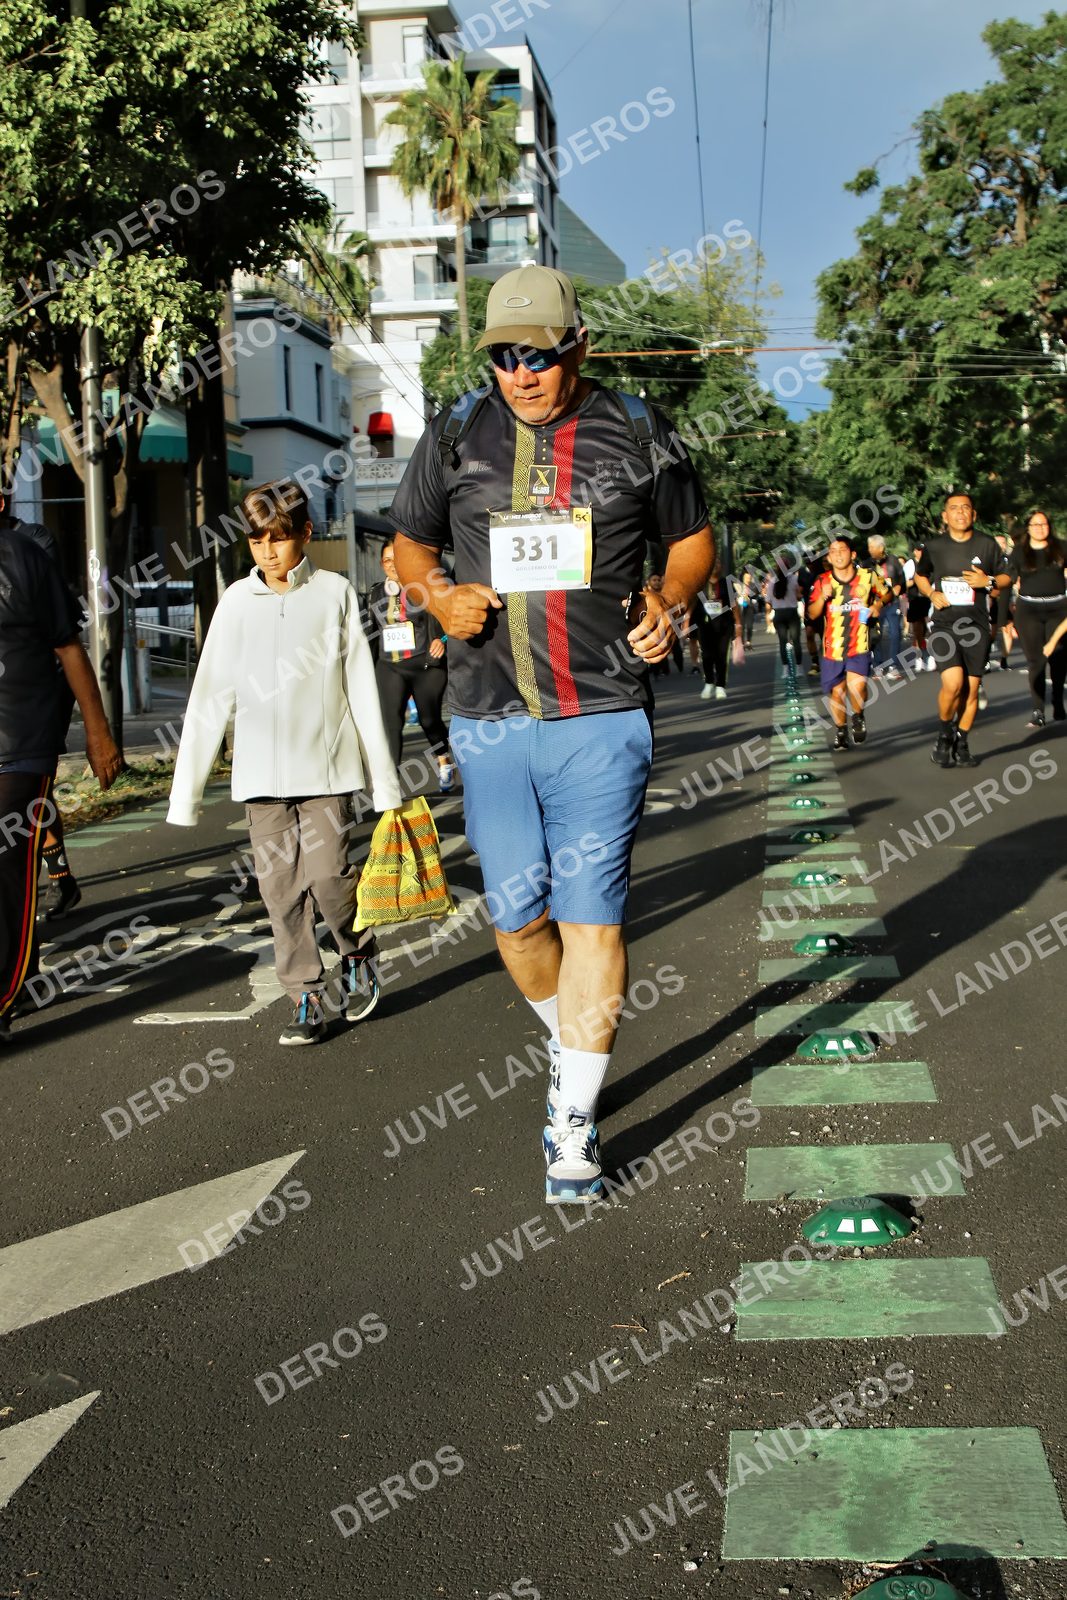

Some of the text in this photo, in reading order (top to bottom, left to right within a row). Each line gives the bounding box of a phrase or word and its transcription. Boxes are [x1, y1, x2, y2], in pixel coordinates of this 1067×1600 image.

[575, 514, 588, 522] 5K
[511, 535, 558, 563] 331
[386, 631, 407, 642] 5026
